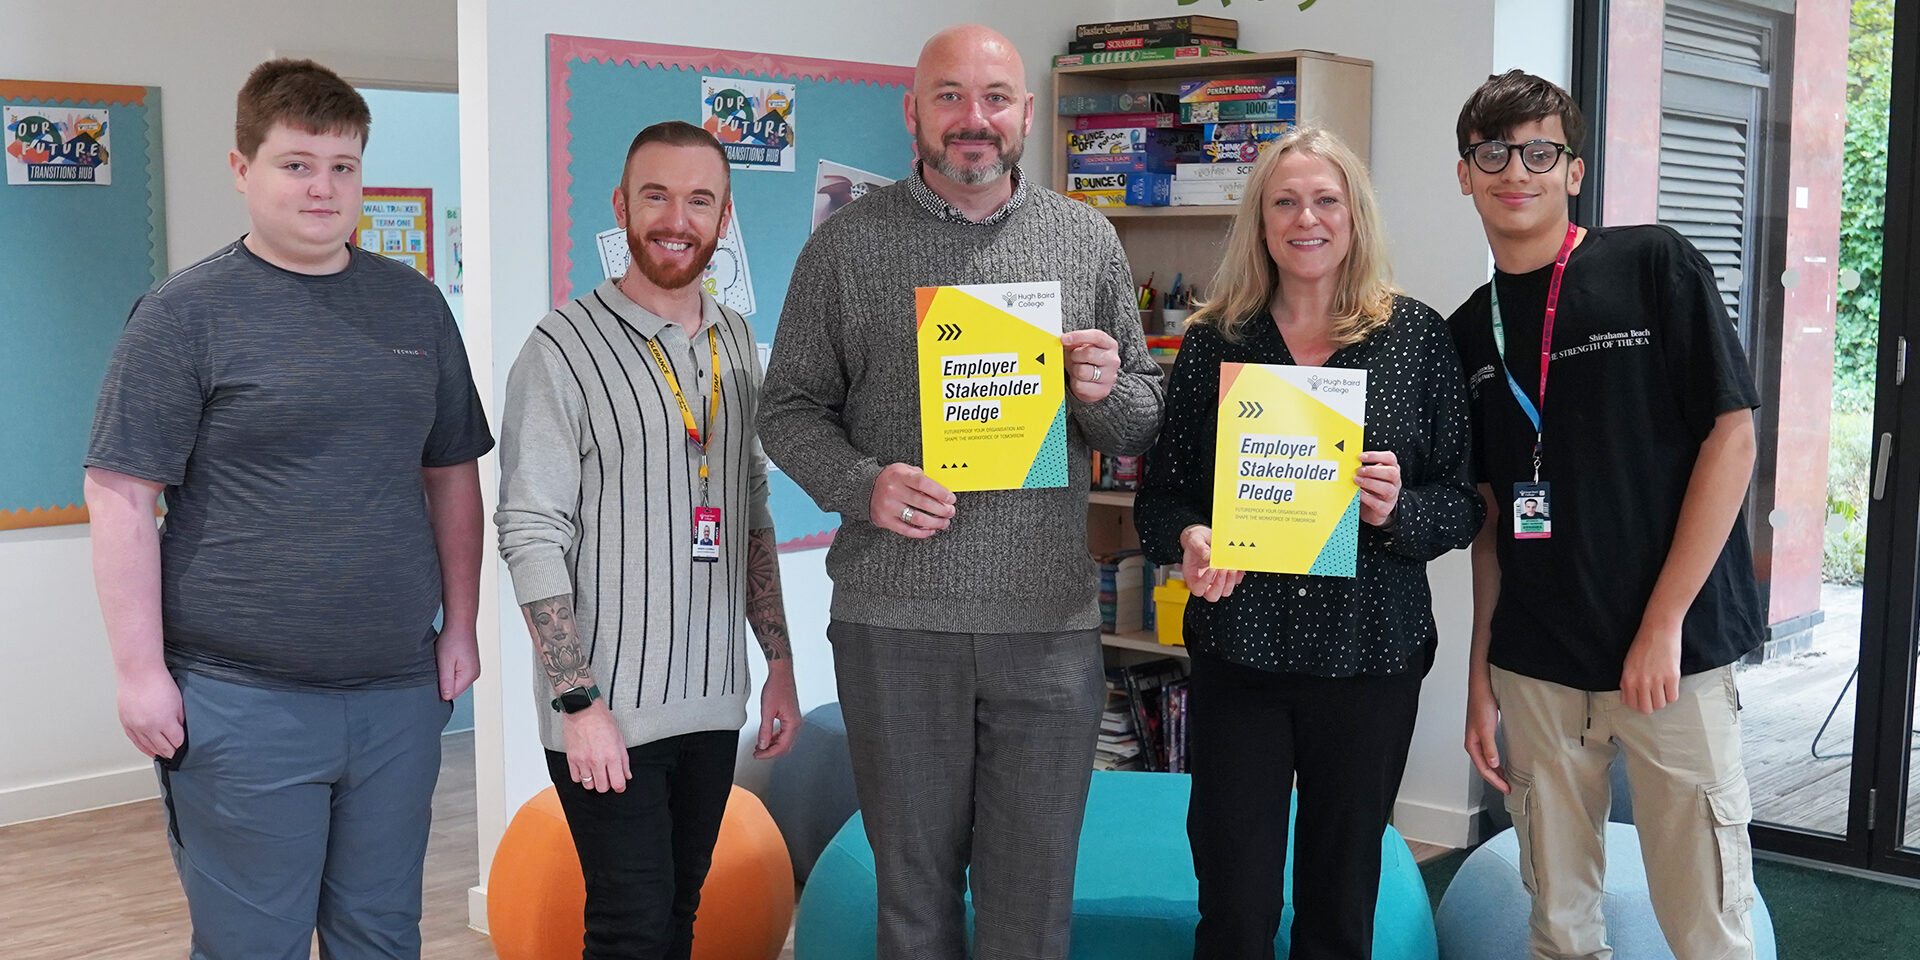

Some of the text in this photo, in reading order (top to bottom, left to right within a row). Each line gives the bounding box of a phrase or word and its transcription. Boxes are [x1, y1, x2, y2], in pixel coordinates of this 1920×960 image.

[1107, 39, 1143, 49] SCRABBLE
[1091, 51, 1140, 64] CLUEDO
[714, 96, 745, 112] OUR
[1245, 102, 1267, 114] 1000
[18, 121, 50, 136] OUR
[717, 120, 787, 138] FUTURE
[22, 142, 98, 157] FUTURE
[1078, 140, 1095, 152] OFF
[1217, 144, 1240, 152] THINK
[724, 145, 780, 163] TRANSITIONS HUB
[30, 165, 94, 179] TRANSITIONS HUB
[364, 205, 419, 213] WALL TRACKER
[376, 219, 411, 227] TERM ONE
[1017, 292, 1036, 301] Hugh
[1588, 329, 1651, 342] Shirahama Beach
[1549, 337, 1650, 362] HE STRENGTH OF THE SEA
[943, 359, 1017, 378] Employer
[945, 379, 1040, 399] Stakeholder
[1323, 378, 1361, 387] Hugh Baird
[1322, 386, 1349, 394] College
[945, 404, 999, 423] Pledge
[1240, 437, 1316, 459] Employer
[1240, 460, 1336, 481] Stakeholder
[1238, 483, 1293, 505] Pledge
